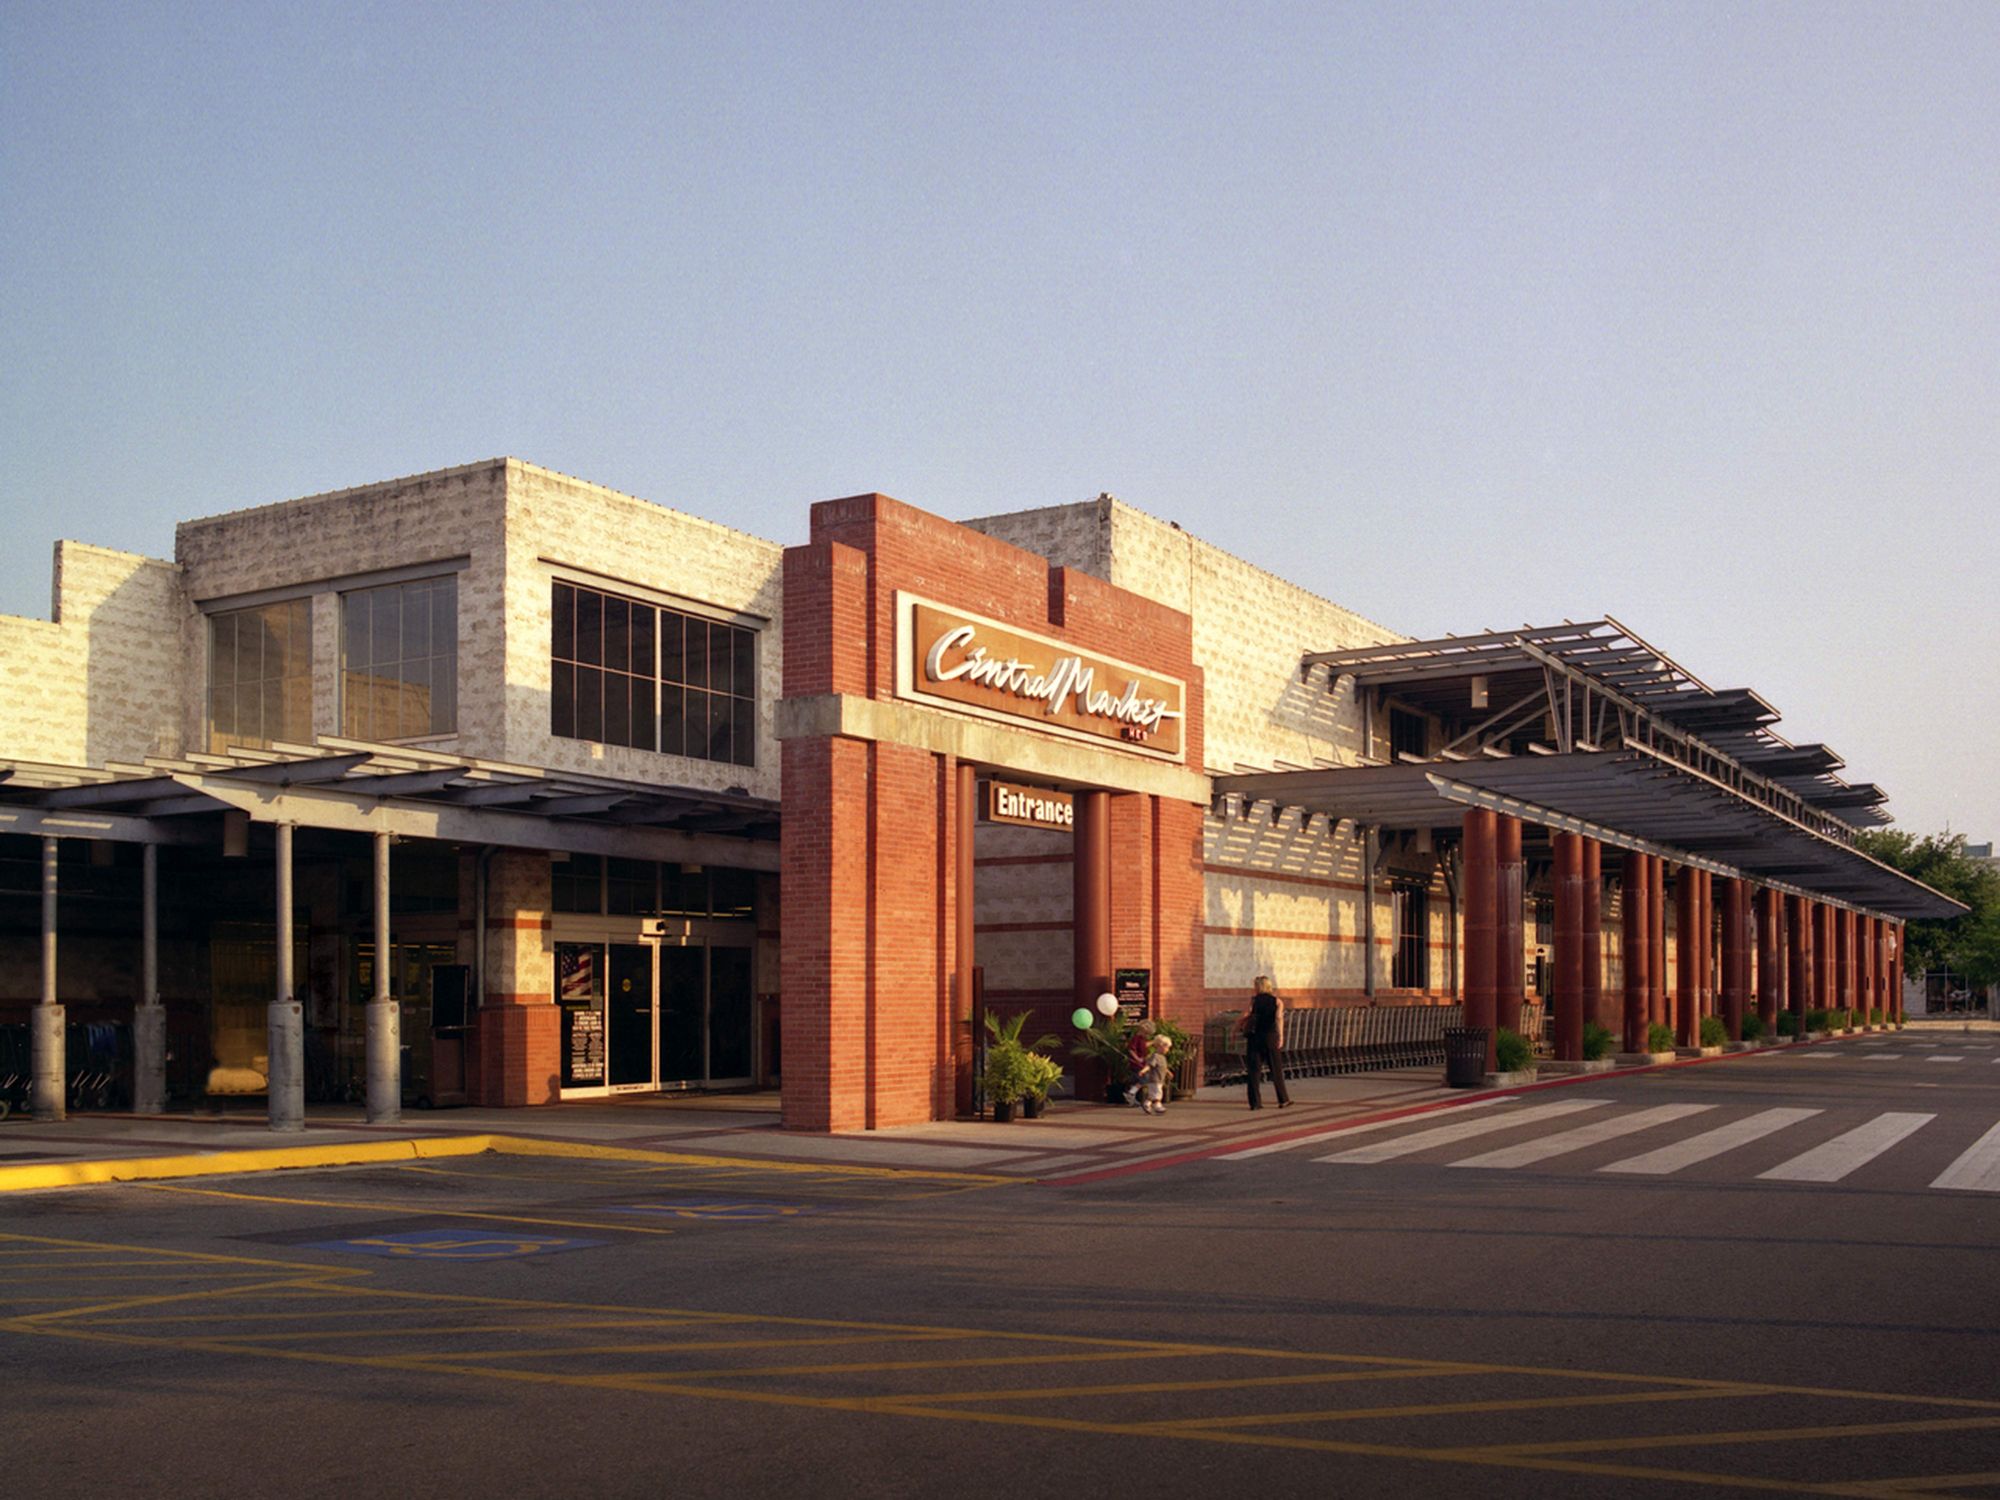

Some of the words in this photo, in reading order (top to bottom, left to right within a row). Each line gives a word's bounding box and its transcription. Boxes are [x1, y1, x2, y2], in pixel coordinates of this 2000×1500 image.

[927, 625, 1069, 704] Central
[1050, 656, 1183, 734] Market
[997, 786, 1073, 825] Entrance
